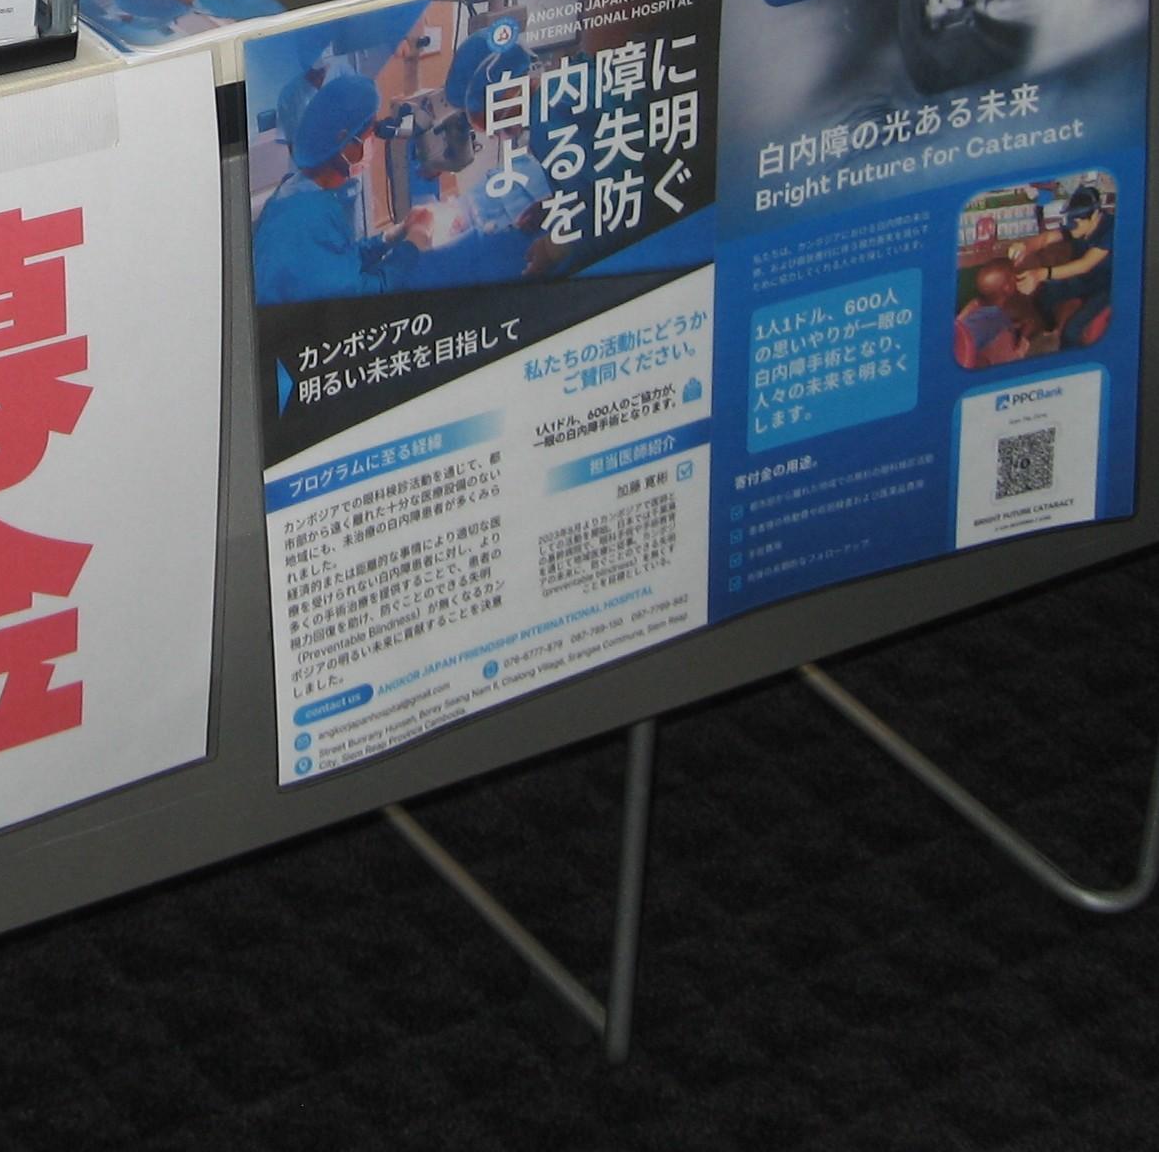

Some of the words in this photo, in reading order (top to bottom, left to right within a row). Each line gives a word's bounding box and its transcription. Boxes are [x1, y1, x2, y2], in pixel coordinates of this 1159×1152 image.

[526, 1, 583, 26] ANGKOR
[526, 9, 628, 41] INTERNATIONAL
[485, 34, 698, 137] 白内障に
[485, 90, 699, 198] よる失明
[758, 82, 1040, 178] 白内障の光ある未来
[755, 175, 830, 212] Bright
[837, 155, 916, 188] Future
[922, 145, 961, 168] for
[967, 119, 1085, 159] Cataract
[541, 158, 693, 245] を防ぐ
[298, 312, 434, 372] カンボジアの
[298, 318, 521, 404] 明るい未来を目指して
[523, 309, 708, 382] 私たちの活動にどうか
[754, 308, 913, 363] の思いやりが一眼の
[754, 336, 902, 388] 白内障手術となり、
[562, 340, 699, 395] ご賛同ください。
[754, 353, 907, 412] 人々の未来を明るく
[1012, 386, 1064, 406] PPCBank
[755, 406, 812, 434] します。
[287, 560, 338, 584] れました。
[293, 674, 345, 699] しました。
